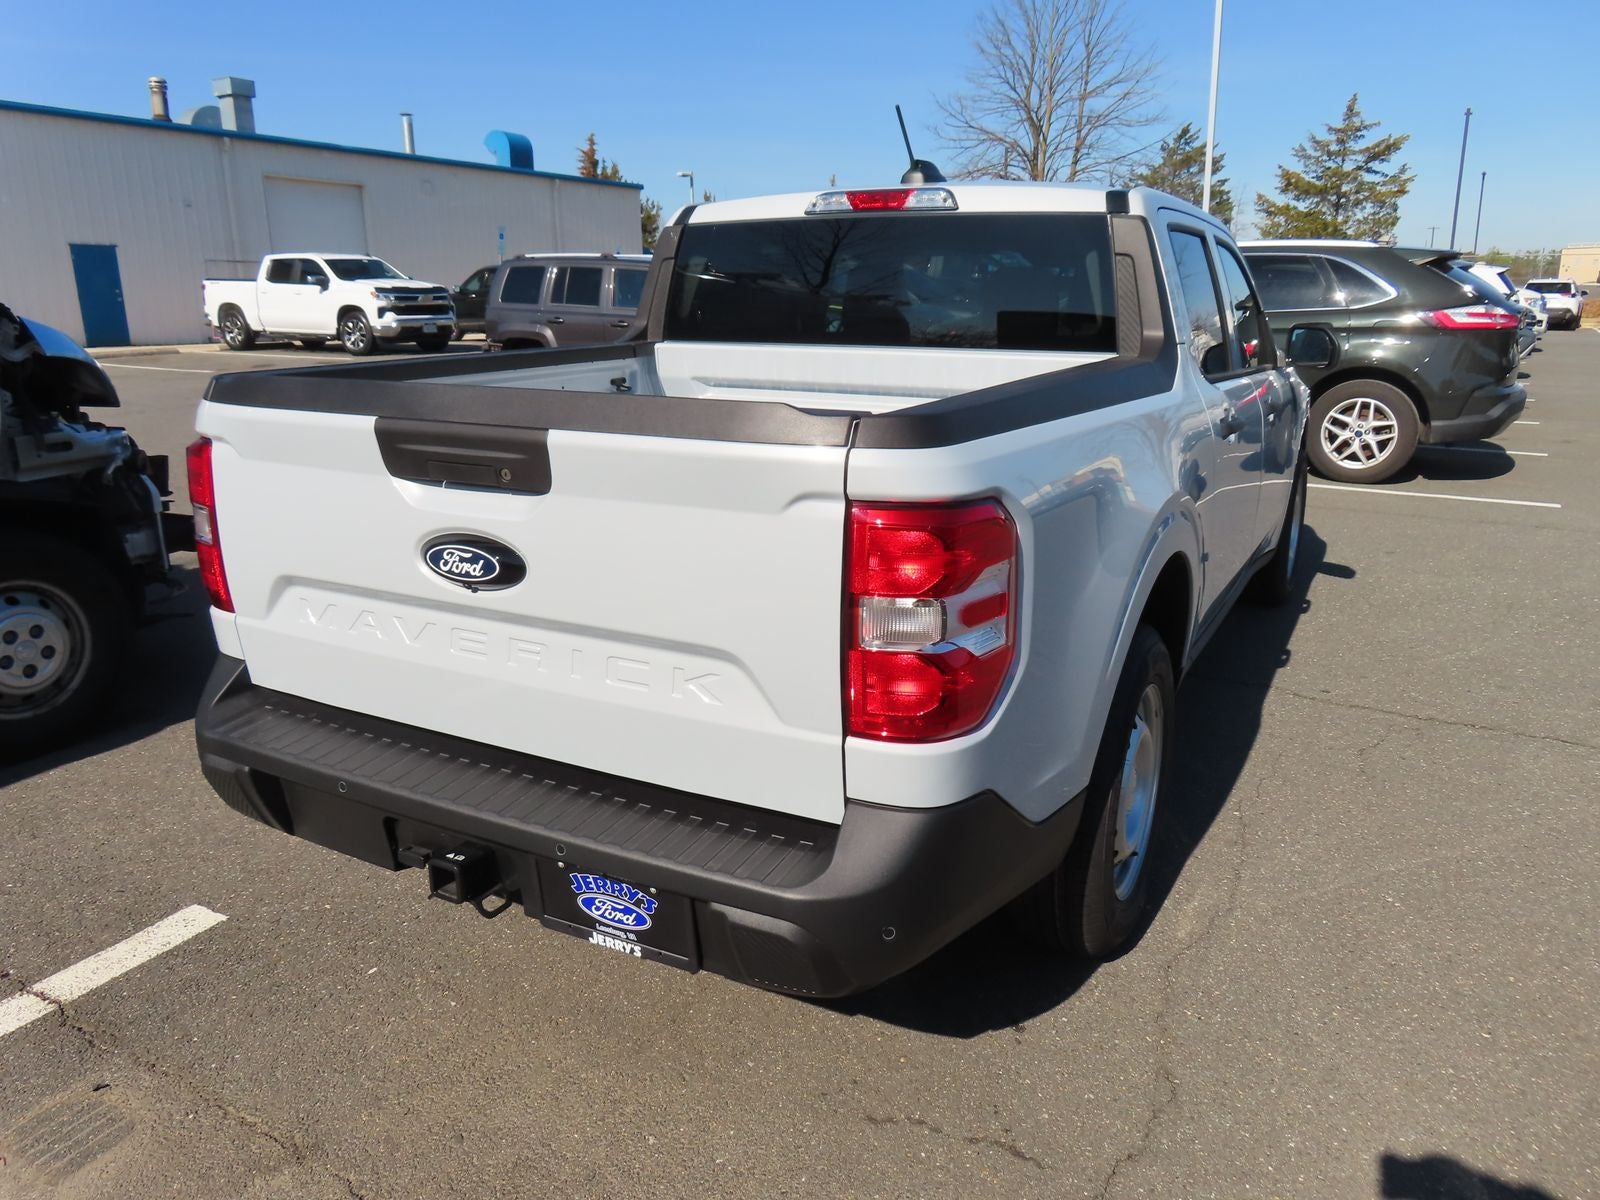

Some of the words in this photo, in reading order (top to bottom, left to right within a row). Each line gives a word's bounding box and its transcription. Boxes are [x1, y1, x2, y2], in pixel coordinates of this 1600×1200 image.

[439, 548, 485, 577] Ford
[298, 597, 725, 706] MAVERICK
[569, 872, 658, 915] JERRY'S
[591, 898, 637, 926] Ford
[588, 931, 642, 957] JERRY'S
